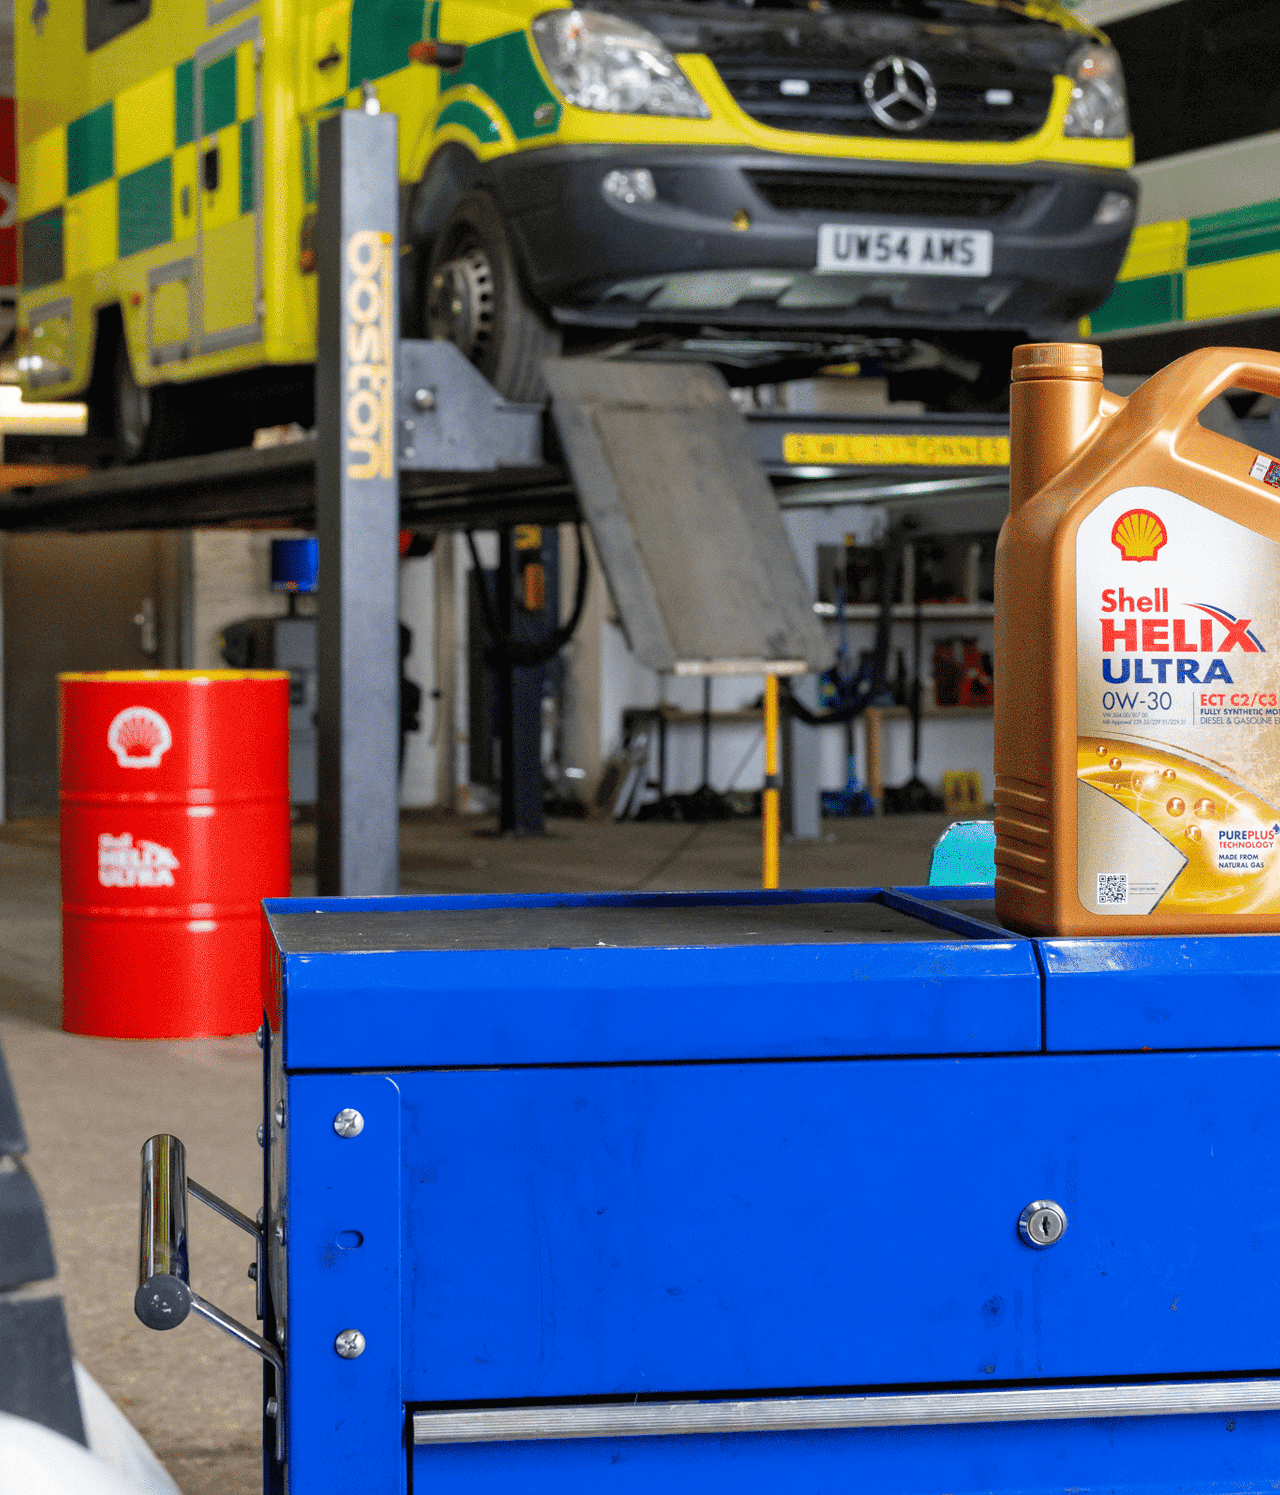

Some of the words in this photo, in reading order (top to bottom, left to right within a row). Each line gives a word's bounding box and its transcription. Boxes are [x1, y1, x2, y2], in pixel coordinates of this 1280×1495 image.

[923, 237, 975, 266] AMS
[1101, 587, 1168, 612] Shell
[1099, 603, 1262, 652] HELIX
[1102, 658, 1234, 684] ULTRA
[1102, 691, 1172, 710] 0W-30
[1200, 694, 1225, 706] ECT
[1230, 693, 1277, 707] C2/C3
[1200, 717, 1224, 725] DIESEL
[1226, 717, 1232, 725] &
[1233, 717, 1272, 725] GASOLINE
[1219, 830, 1274, 840] PUREPLUS
